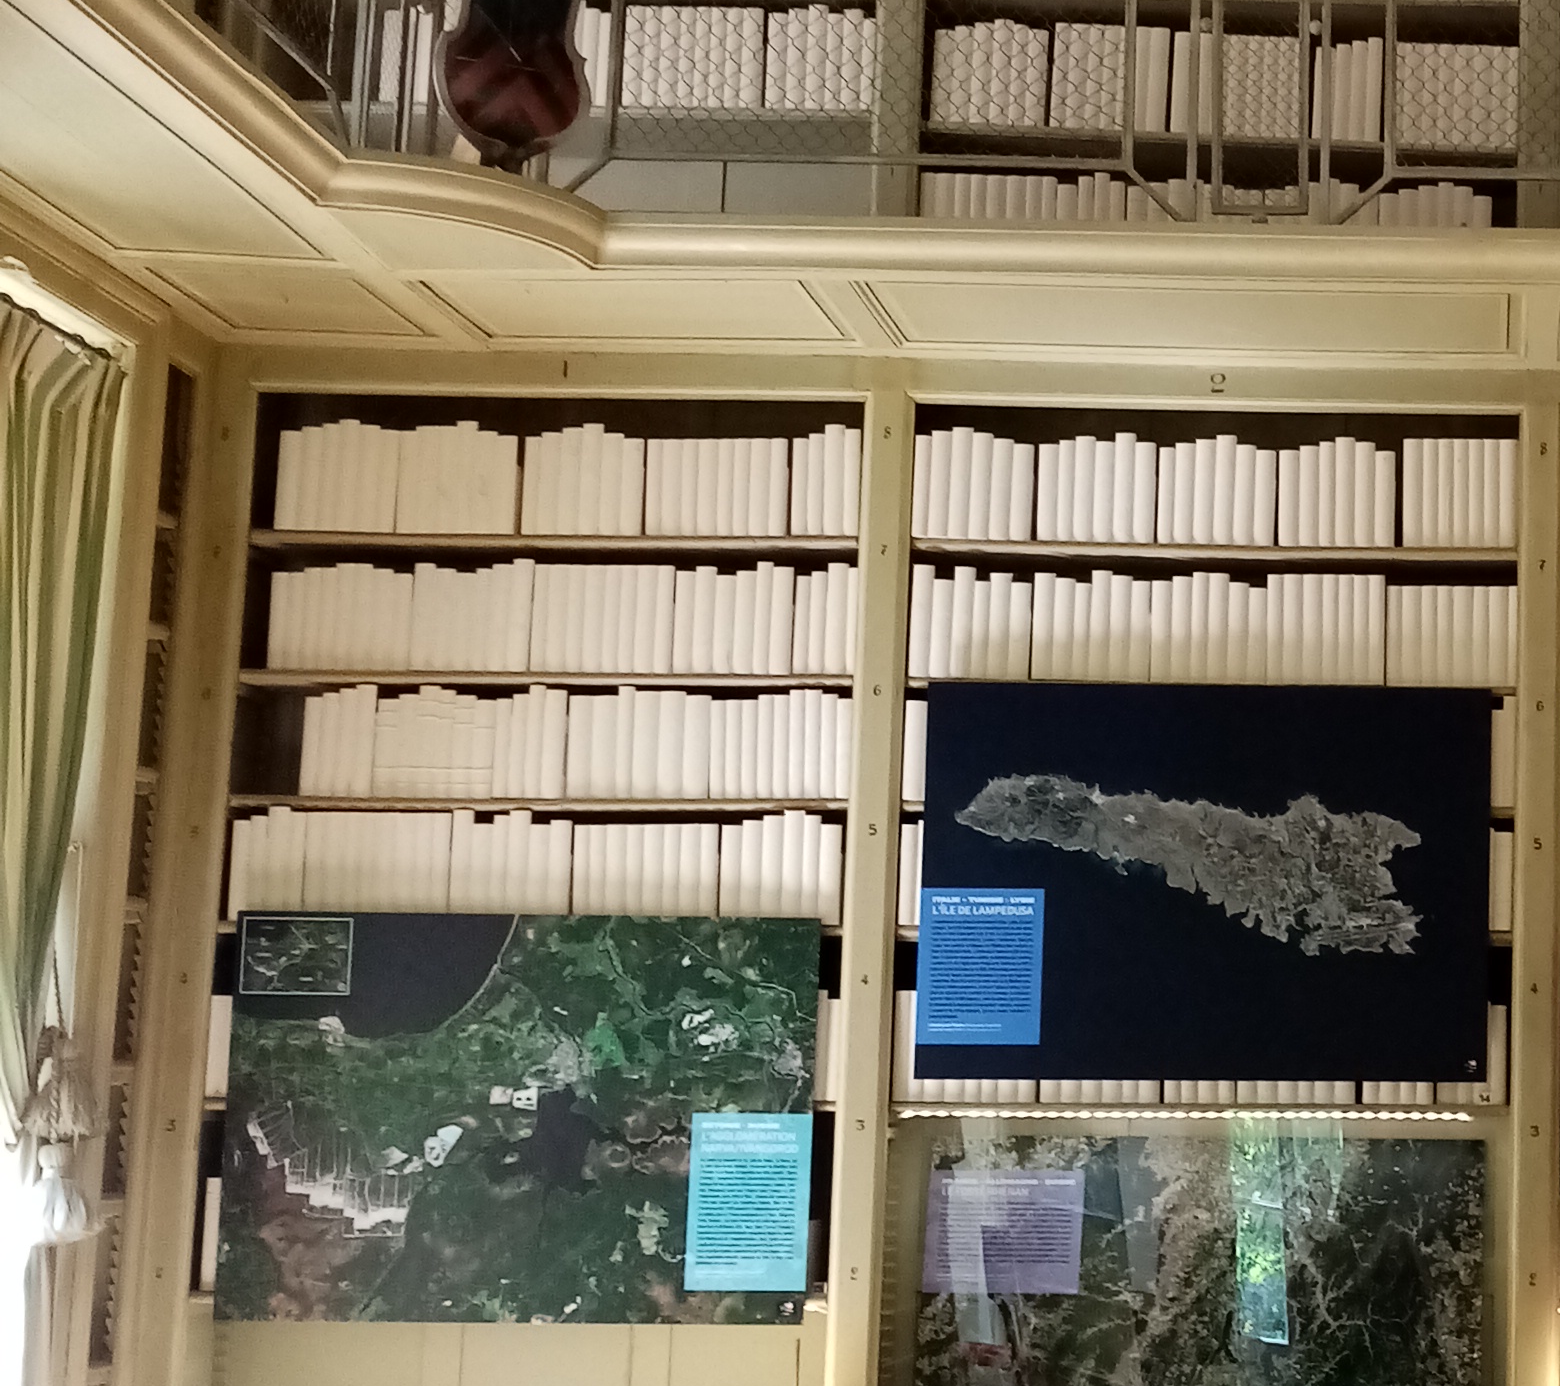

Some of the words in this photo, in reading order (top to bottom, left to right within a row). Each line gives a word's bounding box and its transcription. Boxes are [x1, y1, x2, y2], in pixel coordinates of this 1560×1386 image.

[872, 684, 882, 697] 6
[1535, 700, 1545, 712] 6
[868, 823, 878, 837] 5
[1533, 837, 1543, 851] 5
[957, 905, 972, 915] DE
[973, 905, 1034, 916] LAMPEDUSA
[1530, 982, 1539, 995] 4
[855, 1119, 866, 1131] 3
[1530, 1124, 1540, 1138] 3
